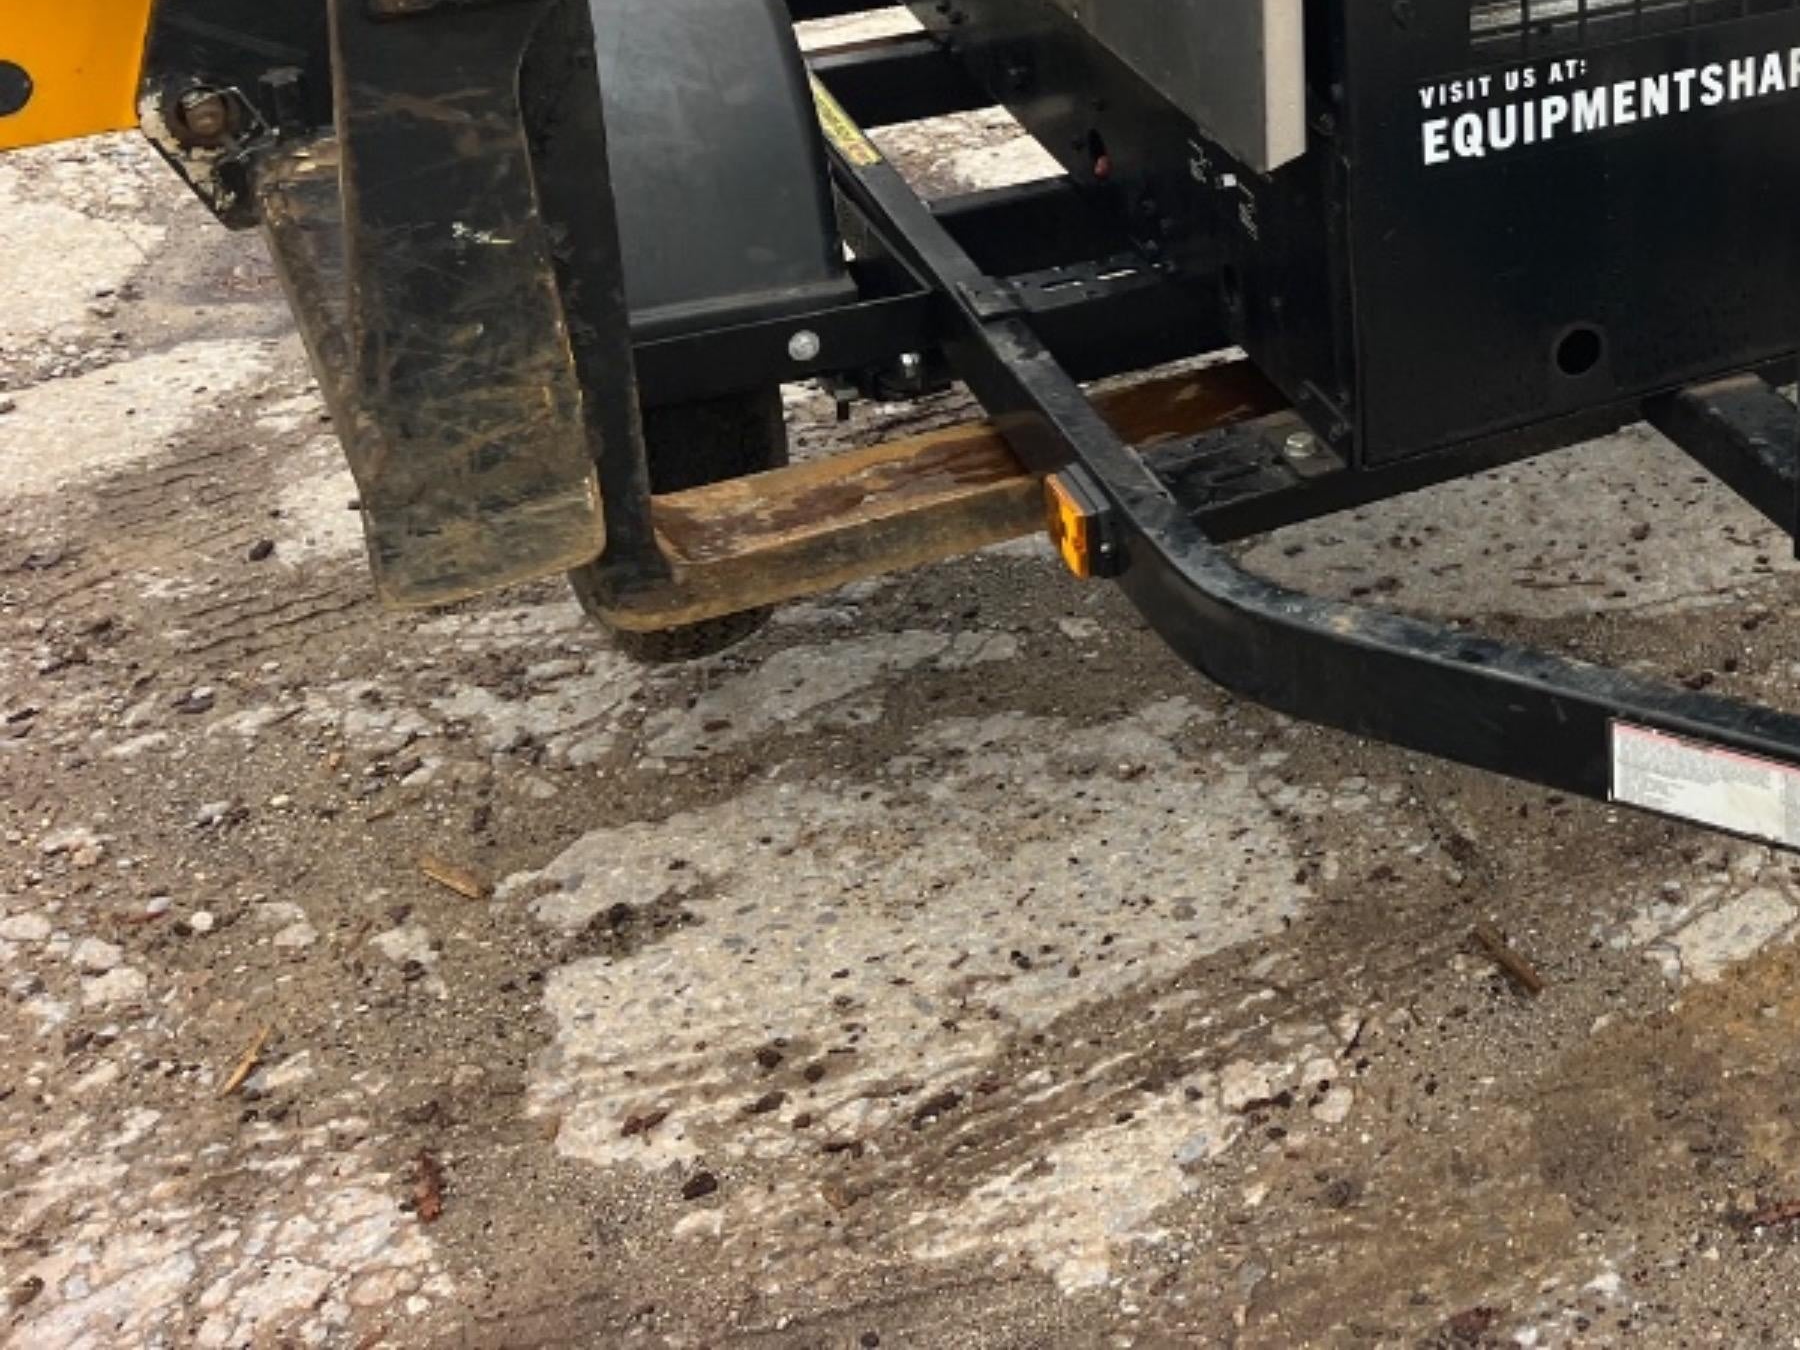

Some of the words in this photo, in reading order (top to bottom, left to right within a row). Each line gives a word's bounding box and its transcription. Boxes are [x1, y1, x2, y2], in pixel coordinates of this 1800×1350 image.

[1418, 75, 1491, 109] VISIT
[1505, 67, 1537, 91] US
[1548, 57, 1588, 82] AT:
